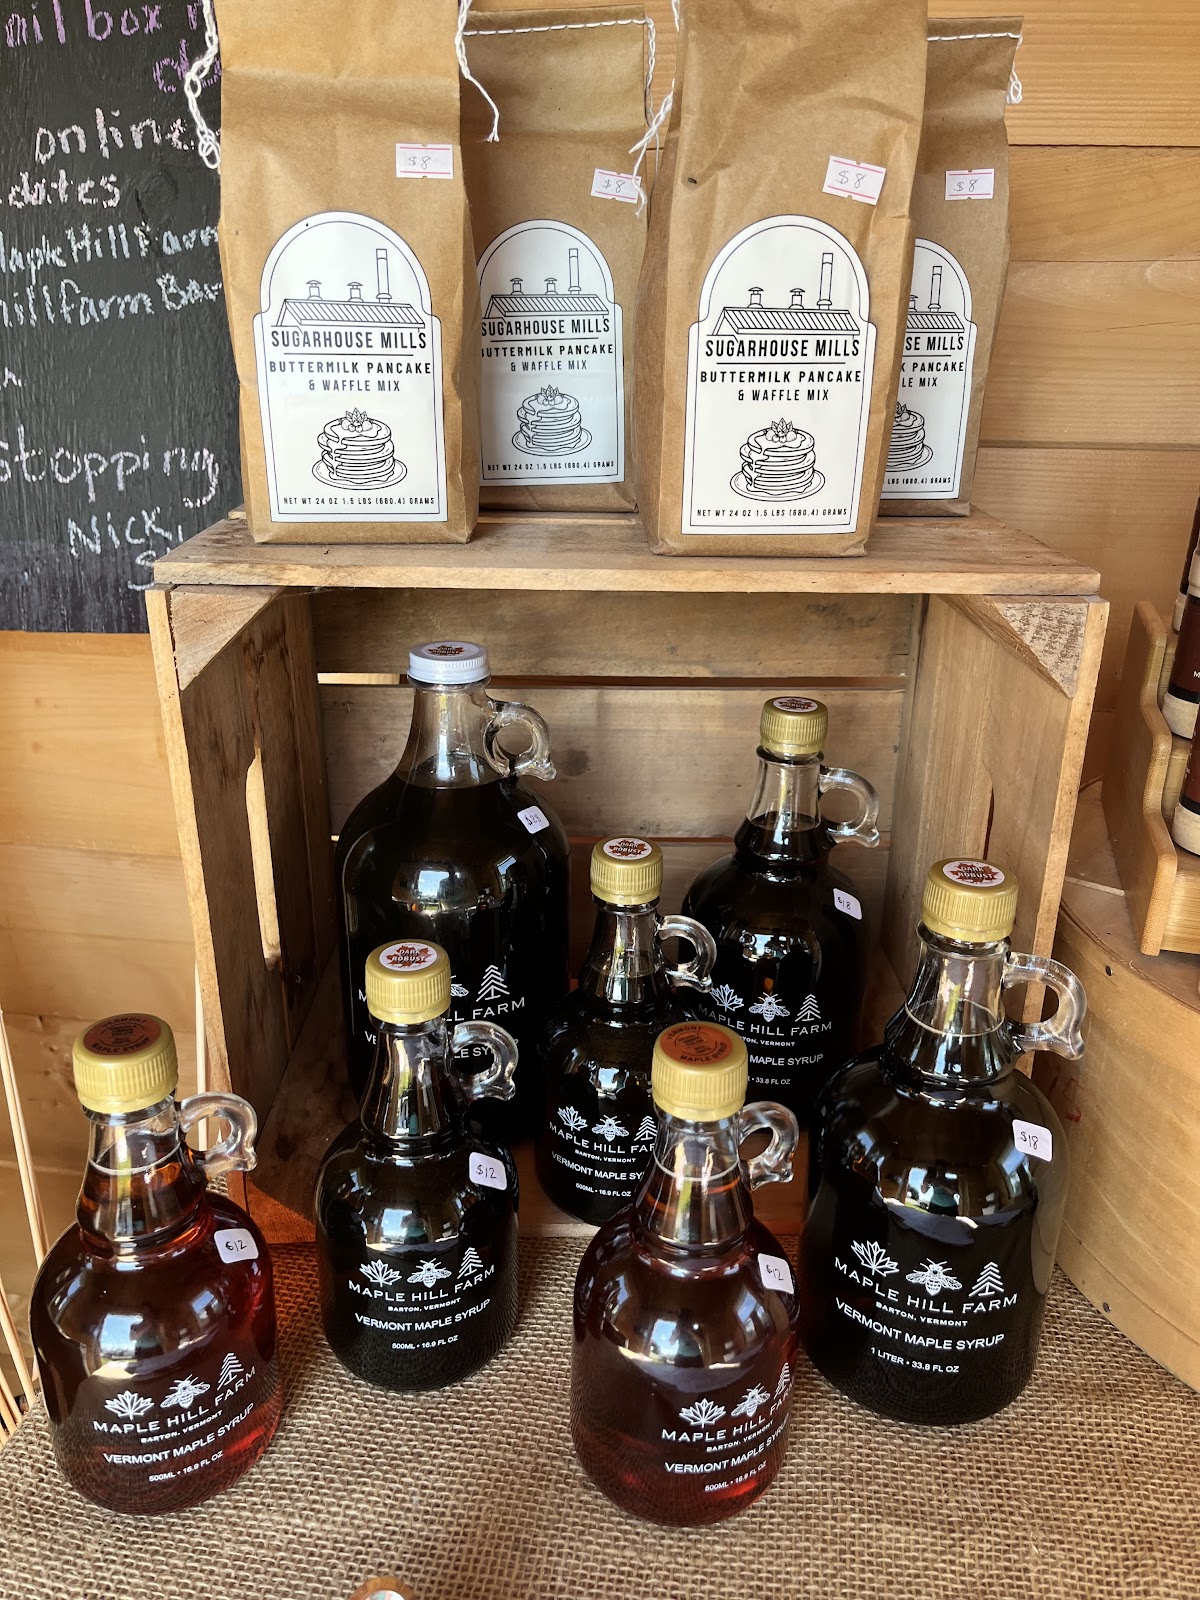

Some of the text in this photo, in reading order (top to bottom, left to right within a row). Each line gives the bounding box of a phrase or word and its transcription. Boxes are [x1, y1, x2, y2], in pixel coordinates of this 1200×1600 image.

[407, 155, 431, 169] $8
[601, 179, 626, 193] $8
[836, 170, 866, 189] $8
[953, 179, 979, 192] $8
[481, 318, 610, 336] SUGARHOUSE MILLS
[271, 330, 426, 349] SUGARHOUSE MILLS
[927, 336, 964, 350] MILLS
[559, 344, 613, 356] PANCAKE
[705, 339, 860, 357] SUGARHOUSE MILLS
[270, 361, 431, 374] BUTTERMILK PANCAKE
[511, 360, 587, 372] & WAFFLE MIX
[912, 362, 964, 372] PANCAKE
[700, 371, 861, 383] BUTTERMILK PANCAKE
[919, 377, 937, 387] MIX
[309, 380, 400, 392] & WAFFLE MIX
[738, 389, 829, 401] & WAFFLE MIX
[823, 508, 847, 516] GRAMS
[473, 997, 525, 1020] FARM
[699, 1004, 832, 1036] MAPLE HILL FARM
[667, 1026, 702, 1039] VERMONT
[91, 1042, 120, 1053] MAPLE
[742, 1036, 758, 1045] TON,
[680, 1054, 710, 1062] MAPLE
[750, 1054, 824, 1066] MAPLE SYRUP
[755, 1076, 770, 1084] 33.8
[549, 1121, 589, 1148] MAPLE
[594, 1142, 625, 1154] HILL
[1020, 1131, 1038, 1149] $18
[475, 1164, 497, 1179] $12
[551, 1151, 593, 1176] VERMONT
[594, 1169, 627, 1180] MAPLE
[575, 1183, 594, 1193] 500ML
[348, 1265, 495, 1302] MAPLE HILL FARM
[834, 1257, 1018, 1314] MAPLE HILL FARM
[424, 1298, 461, 1311] VERMONT
[355, 1298, 490, 1331] VERMONT MAPLE SYRUP
[920, 1316, 968, 1327] VERMONT
[835, 1297, 1005, 1350] VERMONT MAPLE SYRUP
[422, 1341, 437, 1349] 16.9
[448, 1335, 459, 1343] OZ
[877, 1349, 904, 1365] LITER
[912, 1361, 931, 1371] 33.8
[933, 1364, 943, 1373] FL
[93, 1366, 256, 1434] MAPLE HILL FARM
[182, 1410, 223, 1434] VERMONT
[661, 1428, 727, 1442] MAPLE
[733, 1415, 765, 1437] HILL
[103, 1402, 254, 1465] VERMONT MAPLE SYRUP
[743, 1420, 774, 1442] VERMONT
[664, 1459, 729, 1473] VERMONT
[730, 1442, 765, 1467] MAPLE
[149, 1450, 224, 1482] 500ML 16.9 FL OZ
[704, 1481, 729, 1492] 500ML
[758, 1460, 767, 1472] OZ
